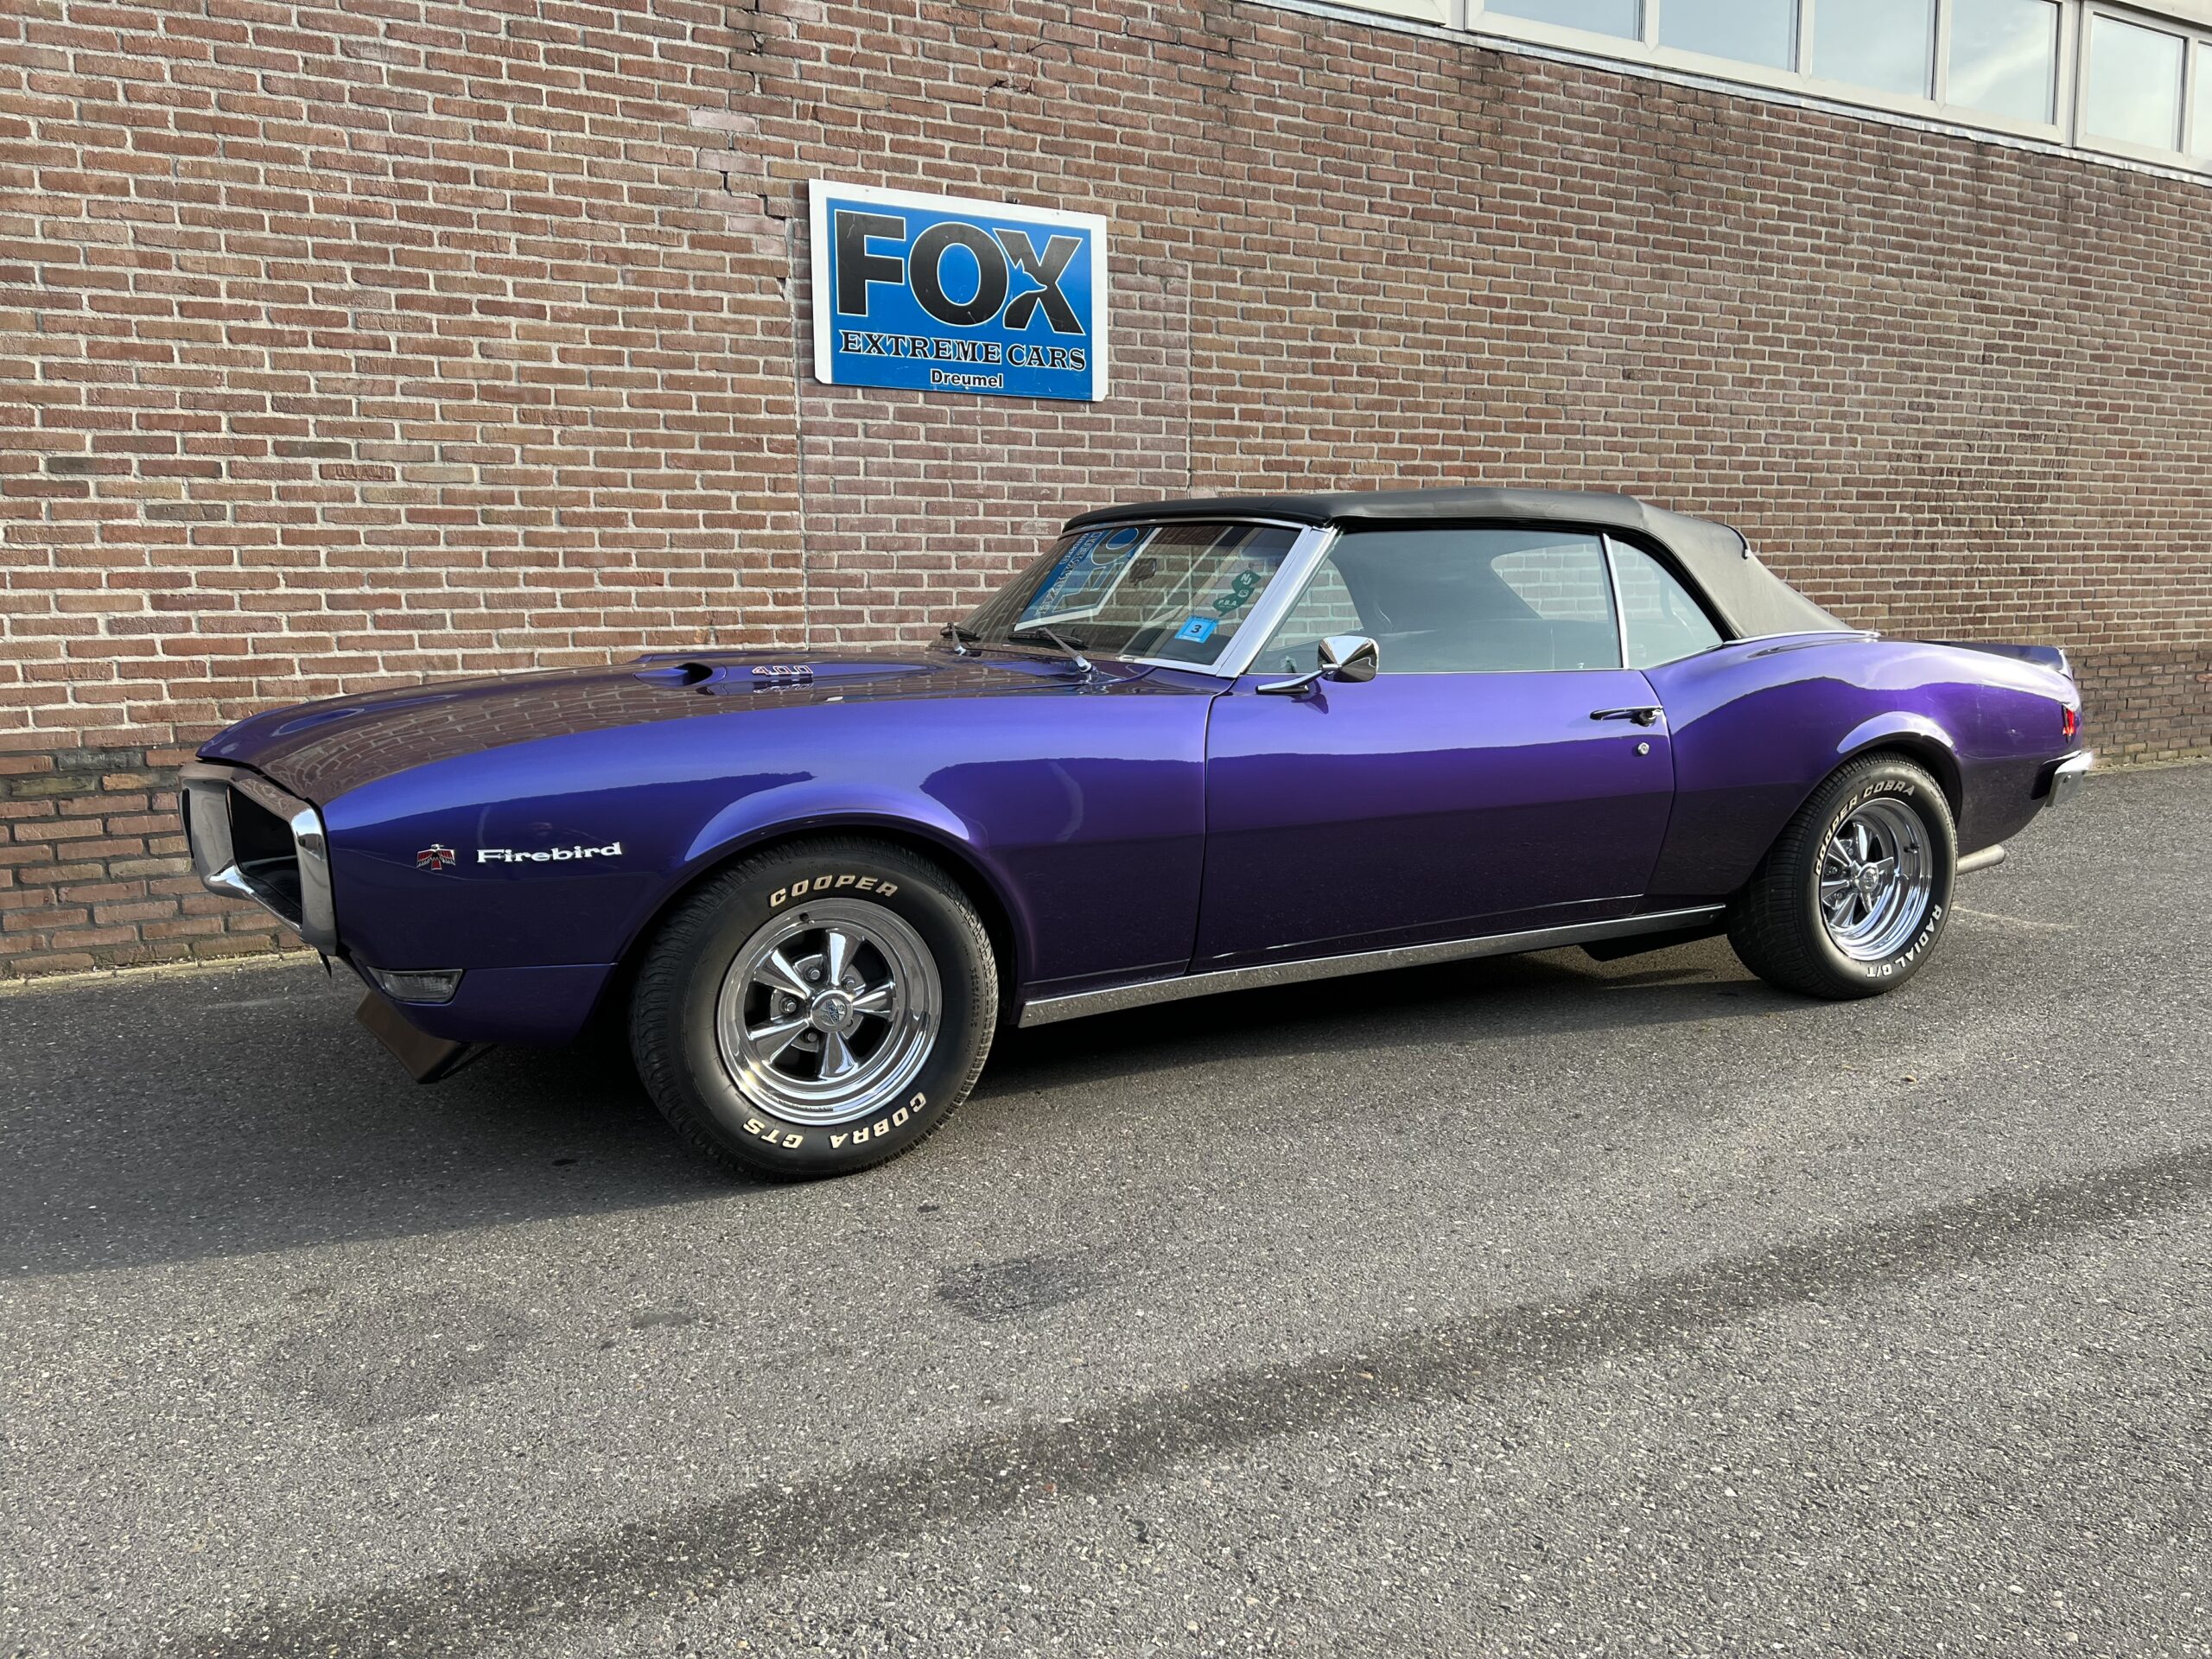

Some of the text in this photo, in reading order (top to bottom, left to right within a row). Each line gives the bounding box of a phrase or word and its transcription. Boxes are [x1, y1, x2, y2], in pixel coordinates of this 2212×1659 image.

[834, 209, 1086, 335] FOX
[838, 329, 1087, 372] EXTREME CARS
[930, 368, 1004, 388] Dreumel
[1190, 624, 1202, 633] 3
[752, 665, 813, 676] 400
[1815, 779, 1916, 876] COOPER COBRA
[477, 842, 623, 863] Firebird
[769, 874, 899, 908] COOPER
[1866, 904, 1942, 977] RADIAL G/T
[742, 1091, 927, 1149] COBRA GTS
